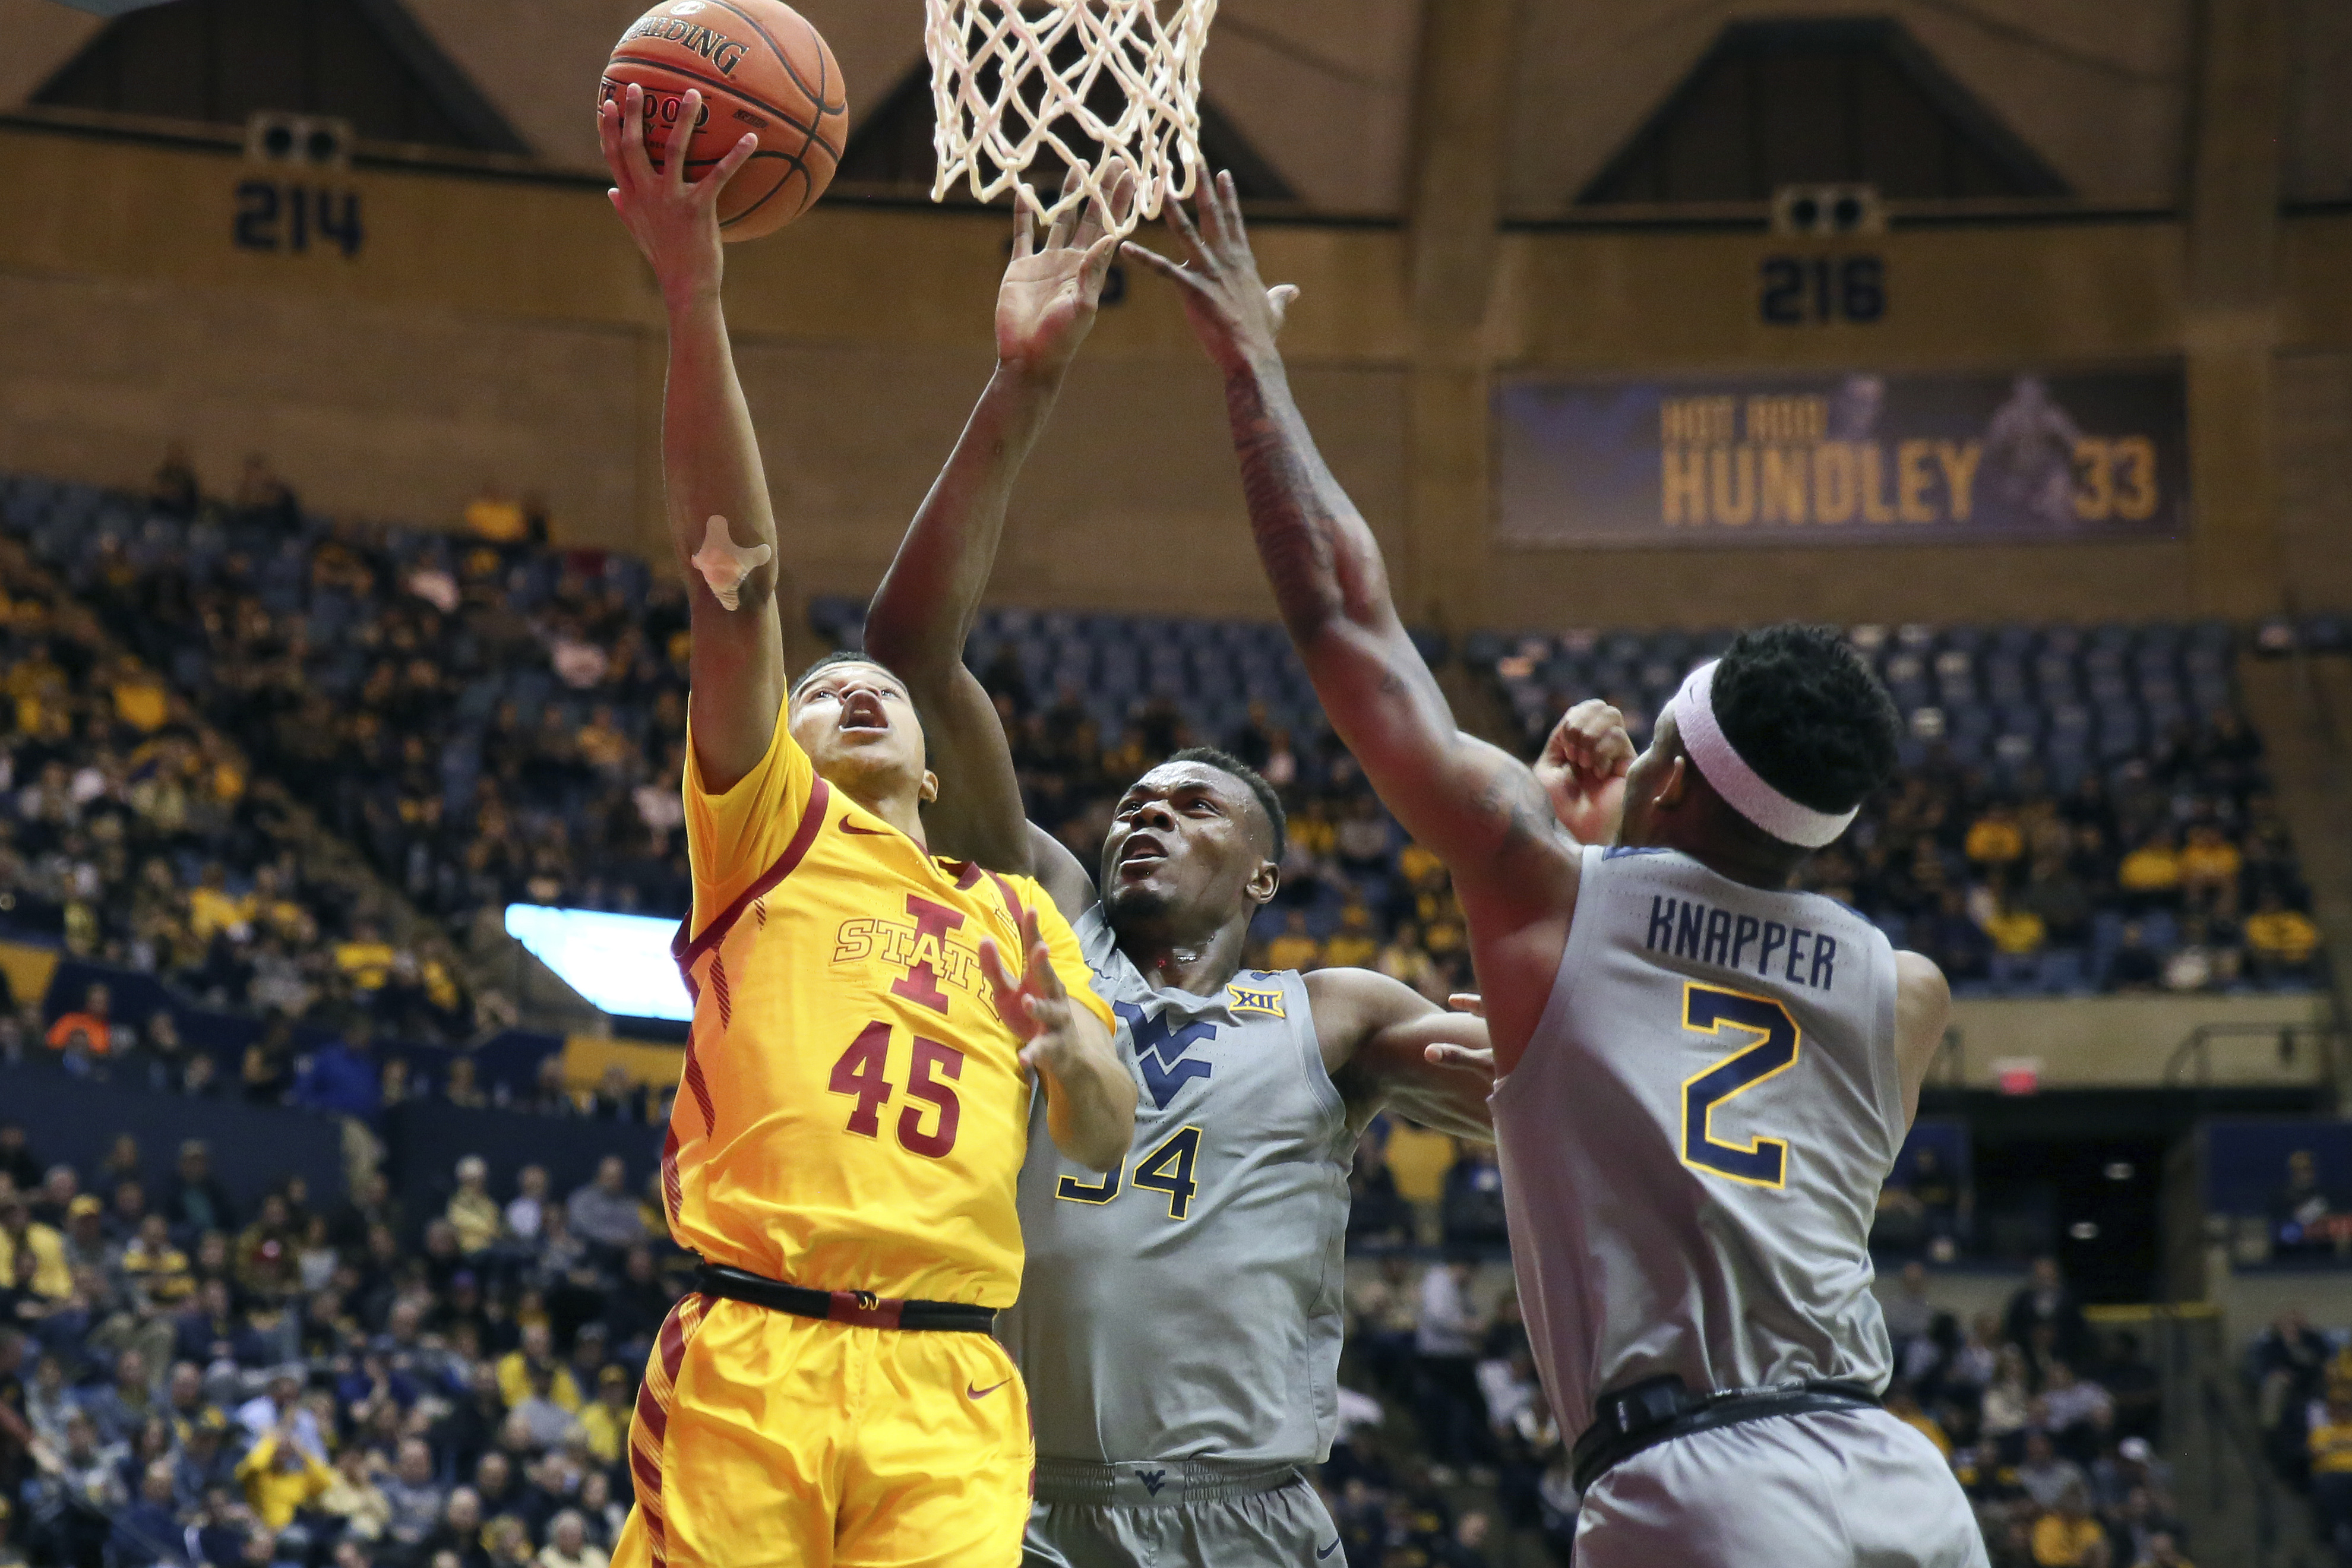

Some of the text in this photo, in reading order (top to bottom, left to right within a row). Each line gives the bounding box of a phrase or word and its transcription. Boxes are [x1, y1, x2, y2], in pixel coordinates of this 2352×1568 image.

[233, 181, 363, 258] 214
[1759, 254, 1887, 324] 216
[1659, 438, 1983, 526] HUNDLEY
[2072, 435, 2158, 520] 33
[1647, 894, 1838, 991] KNAPPER
[827, 1019, 965, 1158] 45
[1680, 979, 1801, 1190] 2
